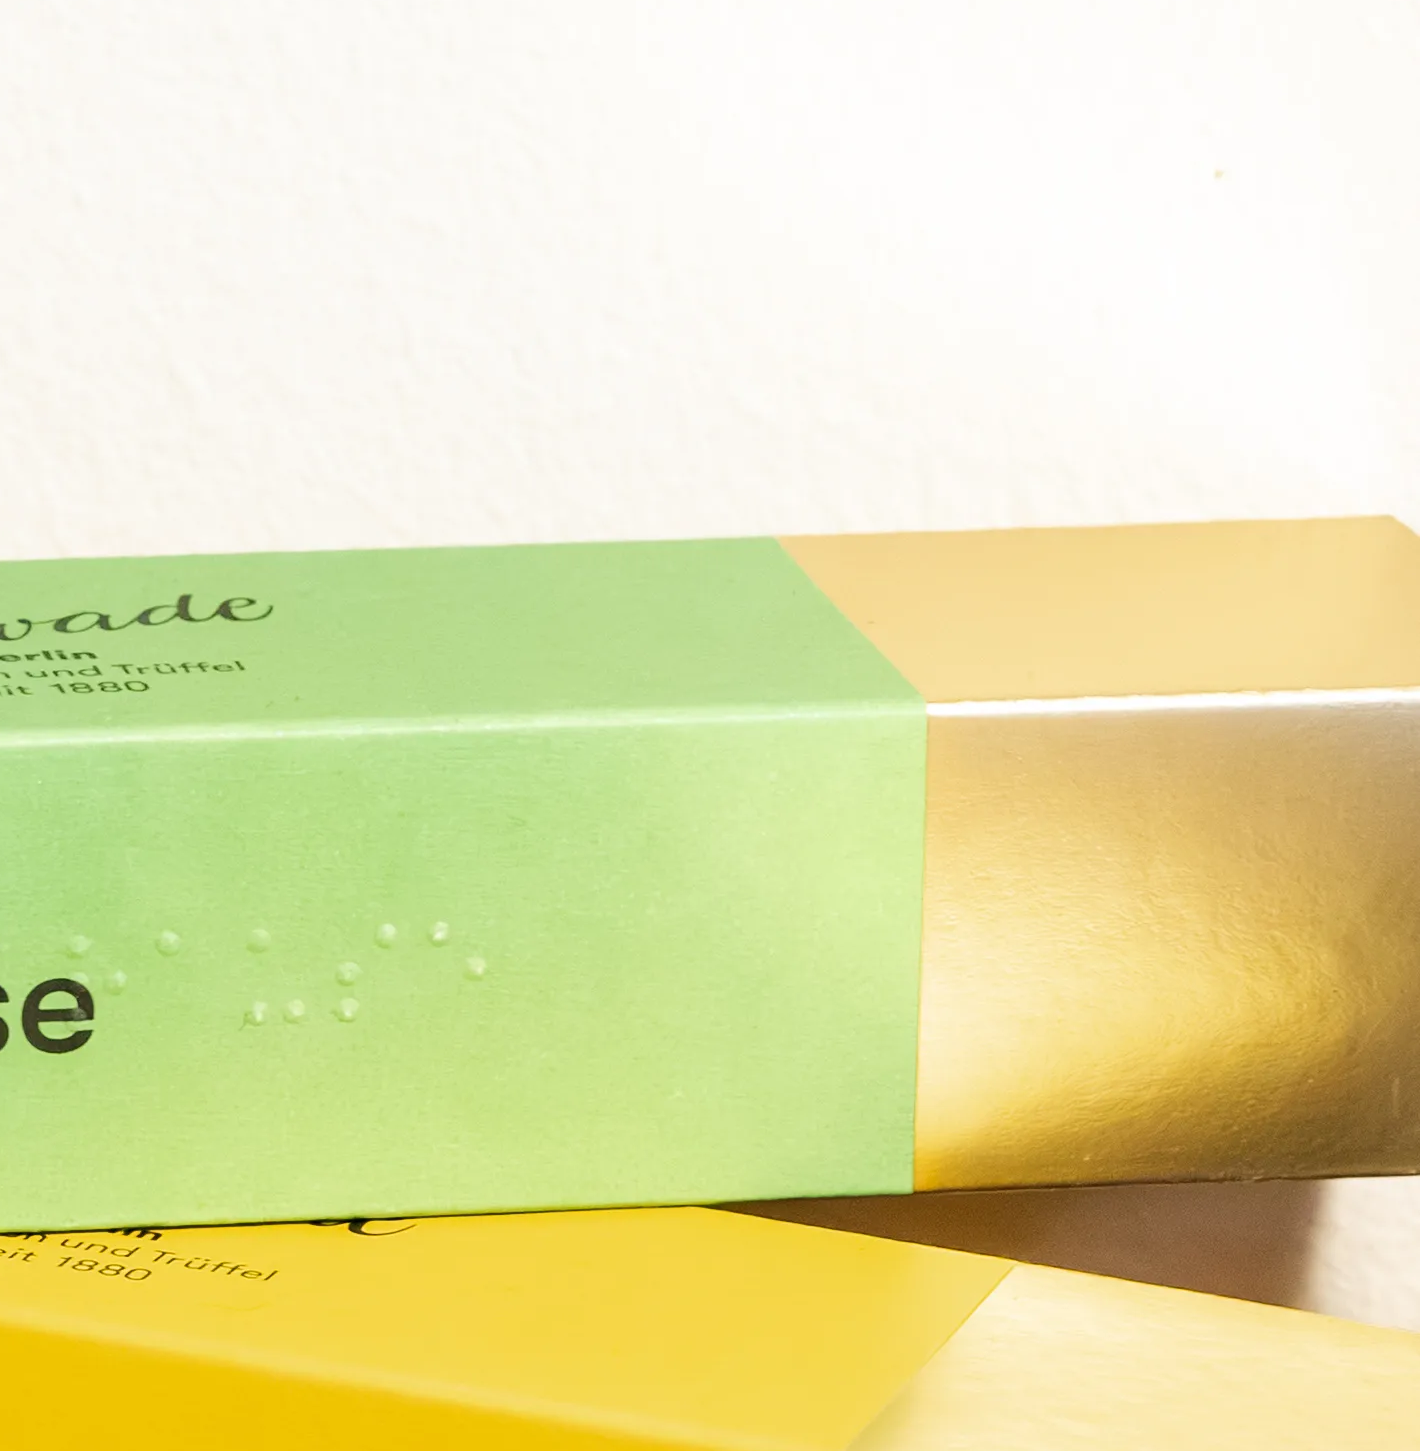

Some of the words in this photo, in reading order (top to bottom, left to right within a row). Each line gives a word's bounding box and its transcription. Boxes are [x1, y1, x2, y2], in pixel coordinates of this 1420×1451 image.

[26, 664, 100, 679] und
[119, 658, 246, 677] Trüffel
[52, 679, 150, 694] 1880
[58, 1256, 152, 1282] 1880
[60, 1238, 140, 1259] und
[152, 1249, 278, 1282] Trüffel
